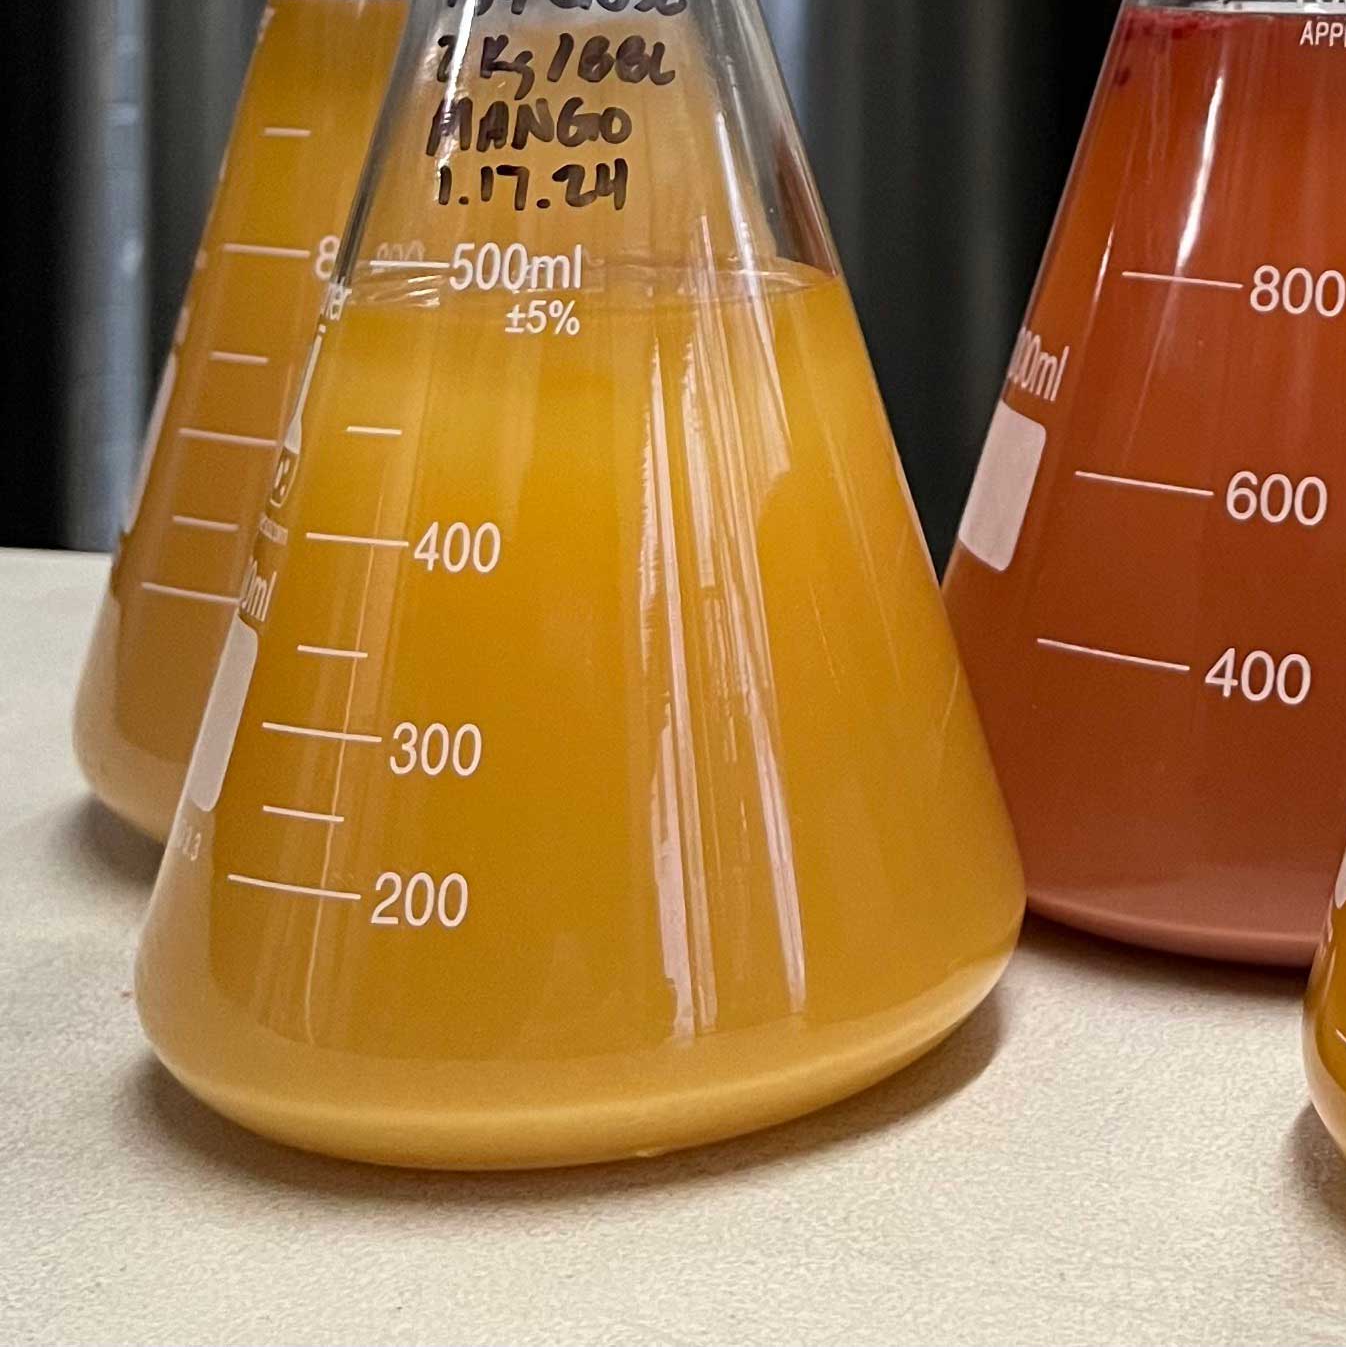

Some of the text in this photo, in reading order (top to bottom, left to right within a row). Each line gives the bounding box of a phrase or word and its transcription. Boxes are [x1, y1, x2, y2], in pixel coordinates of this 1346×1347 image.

[426, 96, 632, 156] MANGO
[438, 158, 628, 211] 1.17.24
[448, 244, 582, 293] 500ml
[1249, 265, 1346, 317] 800
[505, 299, 581, 336] ±5%
[1225, 470, 1328, 526] 600
[413, 521, 501, 574] 400
[1204, 647, 1312, 705] 400
[389, 723, 483, 777] 300
[370, 871, 469, 928] 200
